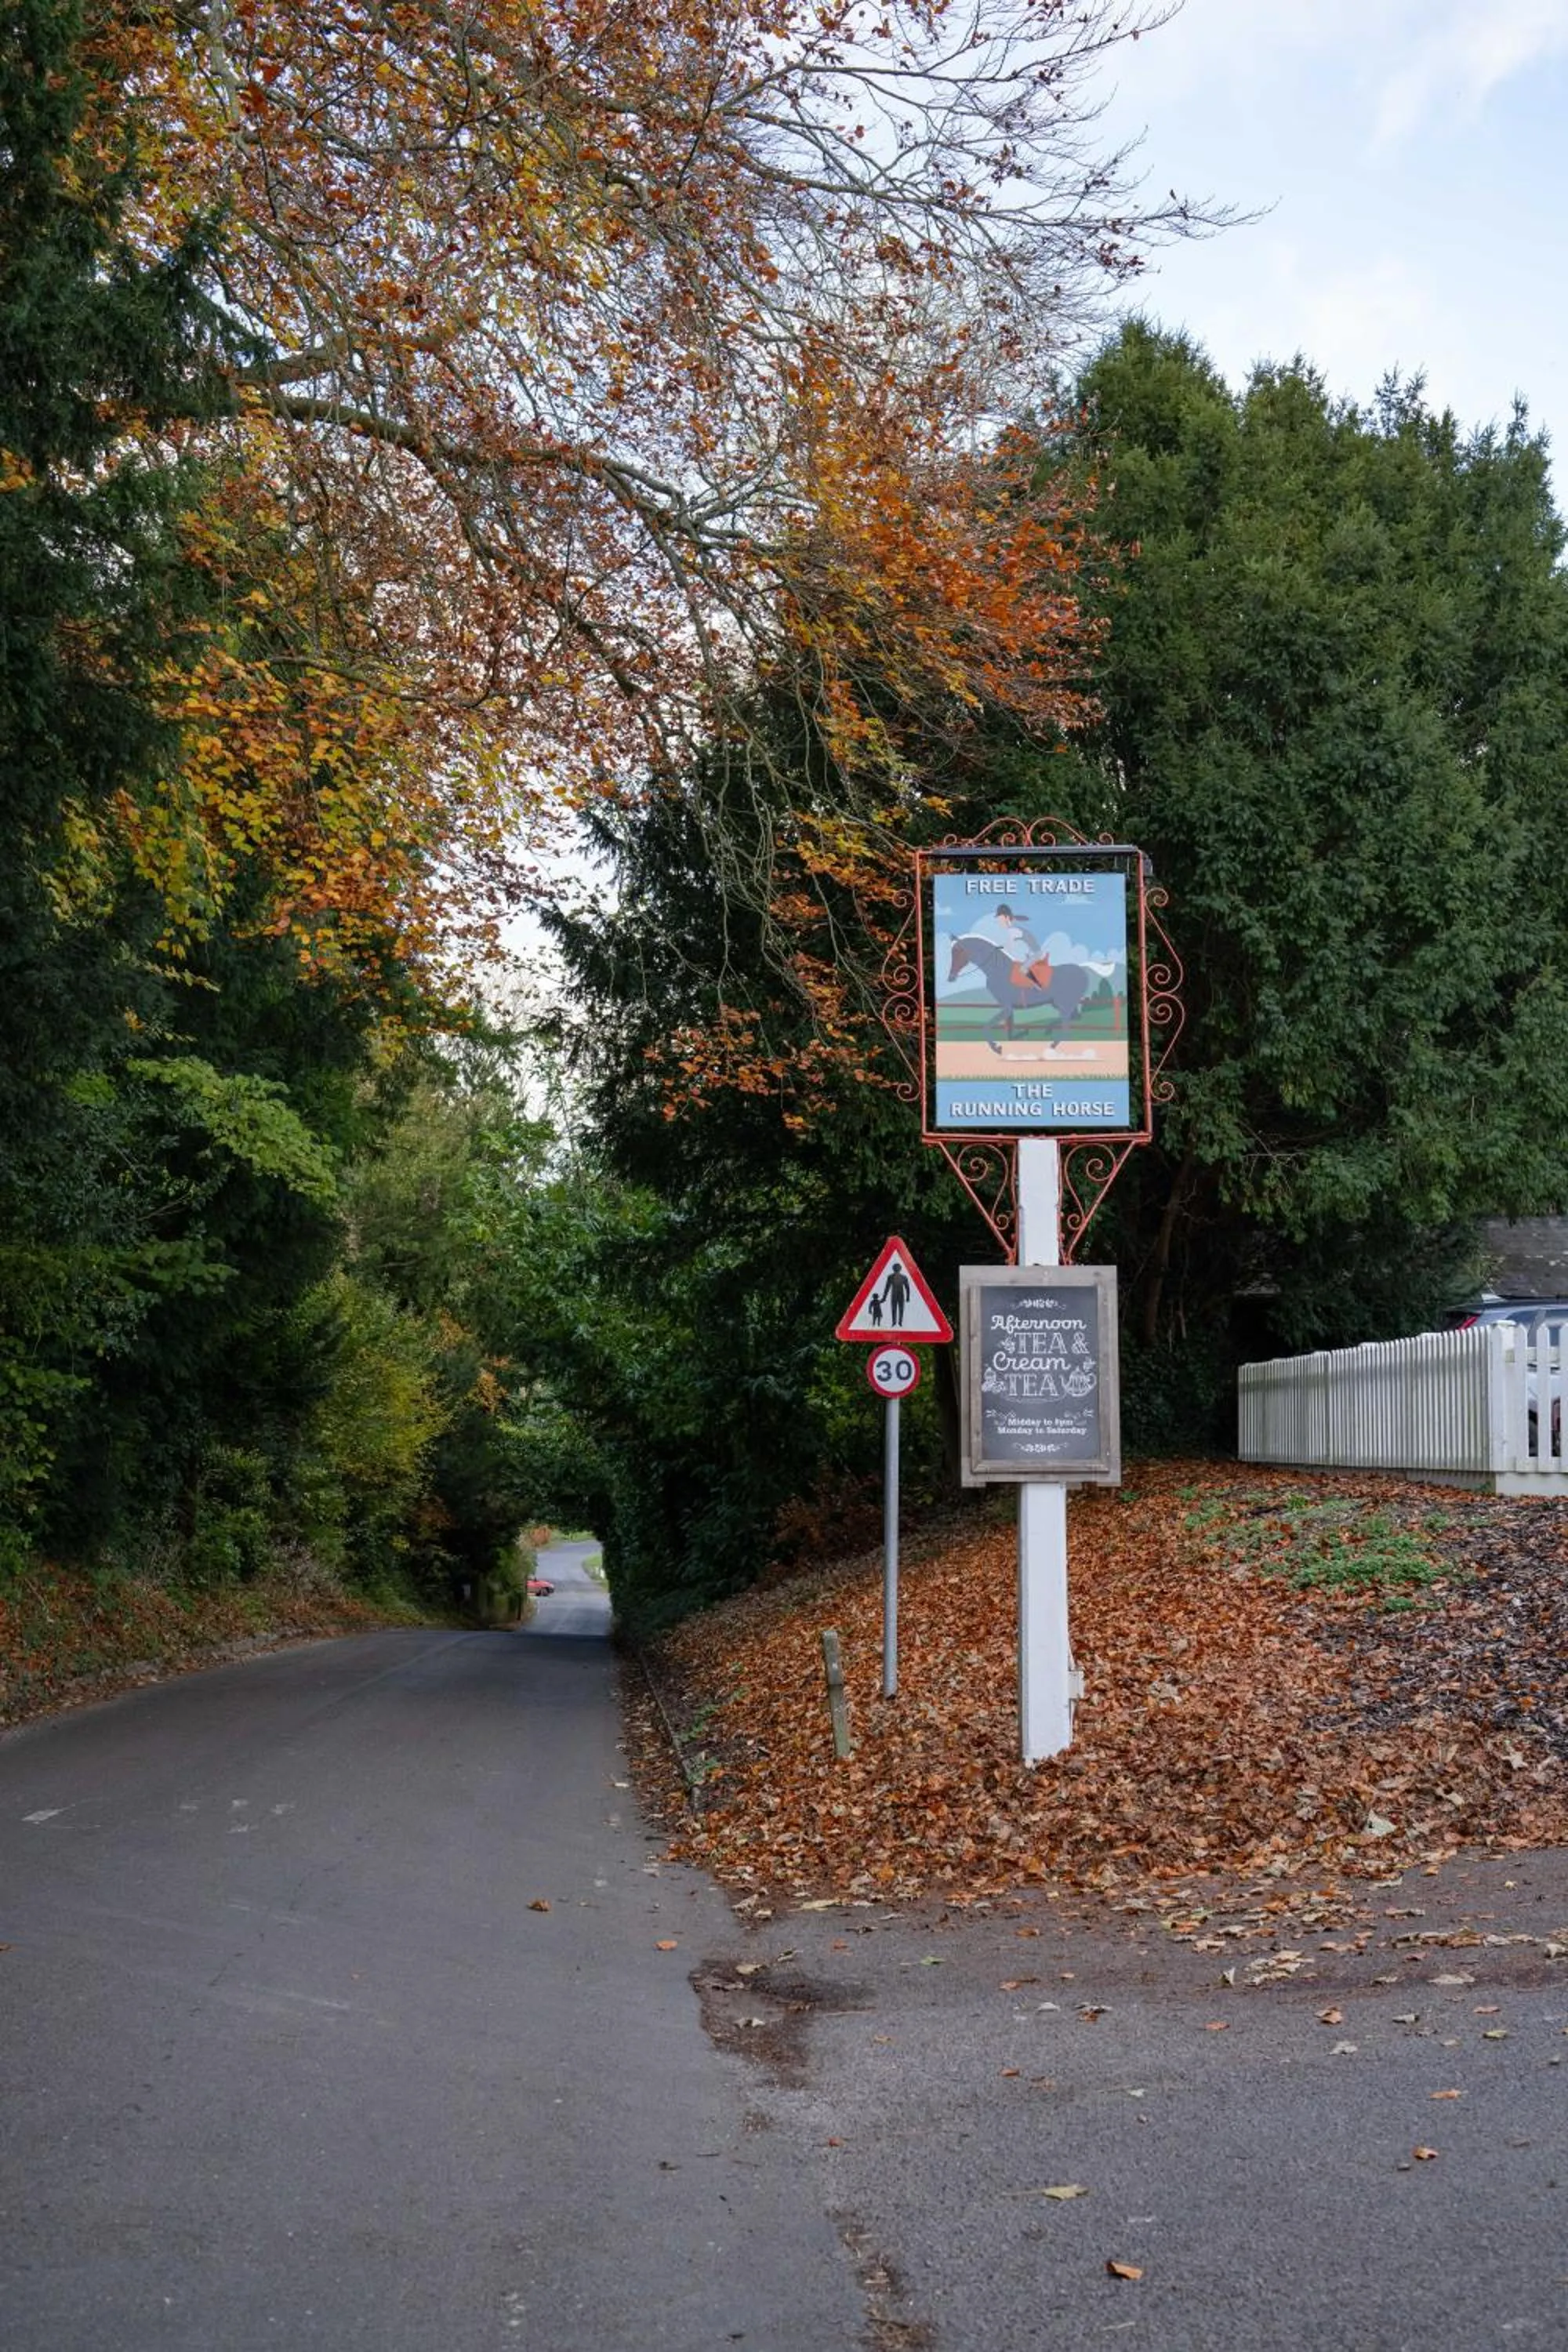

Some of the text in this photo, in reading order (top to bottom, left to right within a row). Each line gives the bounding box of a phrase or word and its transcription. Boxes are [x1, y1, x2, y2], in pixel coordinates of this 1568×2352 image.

[966, 878, 1095, 895] FREE TRADE
[1011, 1083, 1053, 1099] THE
[949, 1101, 1116, 1118] RUNNING HORSE
[990, 1314, 1087, 1334] Afternoon
[1014, 1331, 1091, 1355] TEA &
[875, 1359, 913, 1382] 30
[993, 1351, 1072, 1371] Cream
[1004, 1373, 1060, 1396] TEA
[997, 1426, 1033, 1436] Monday
[1047, 1426, 1087, 1436] Saturday
